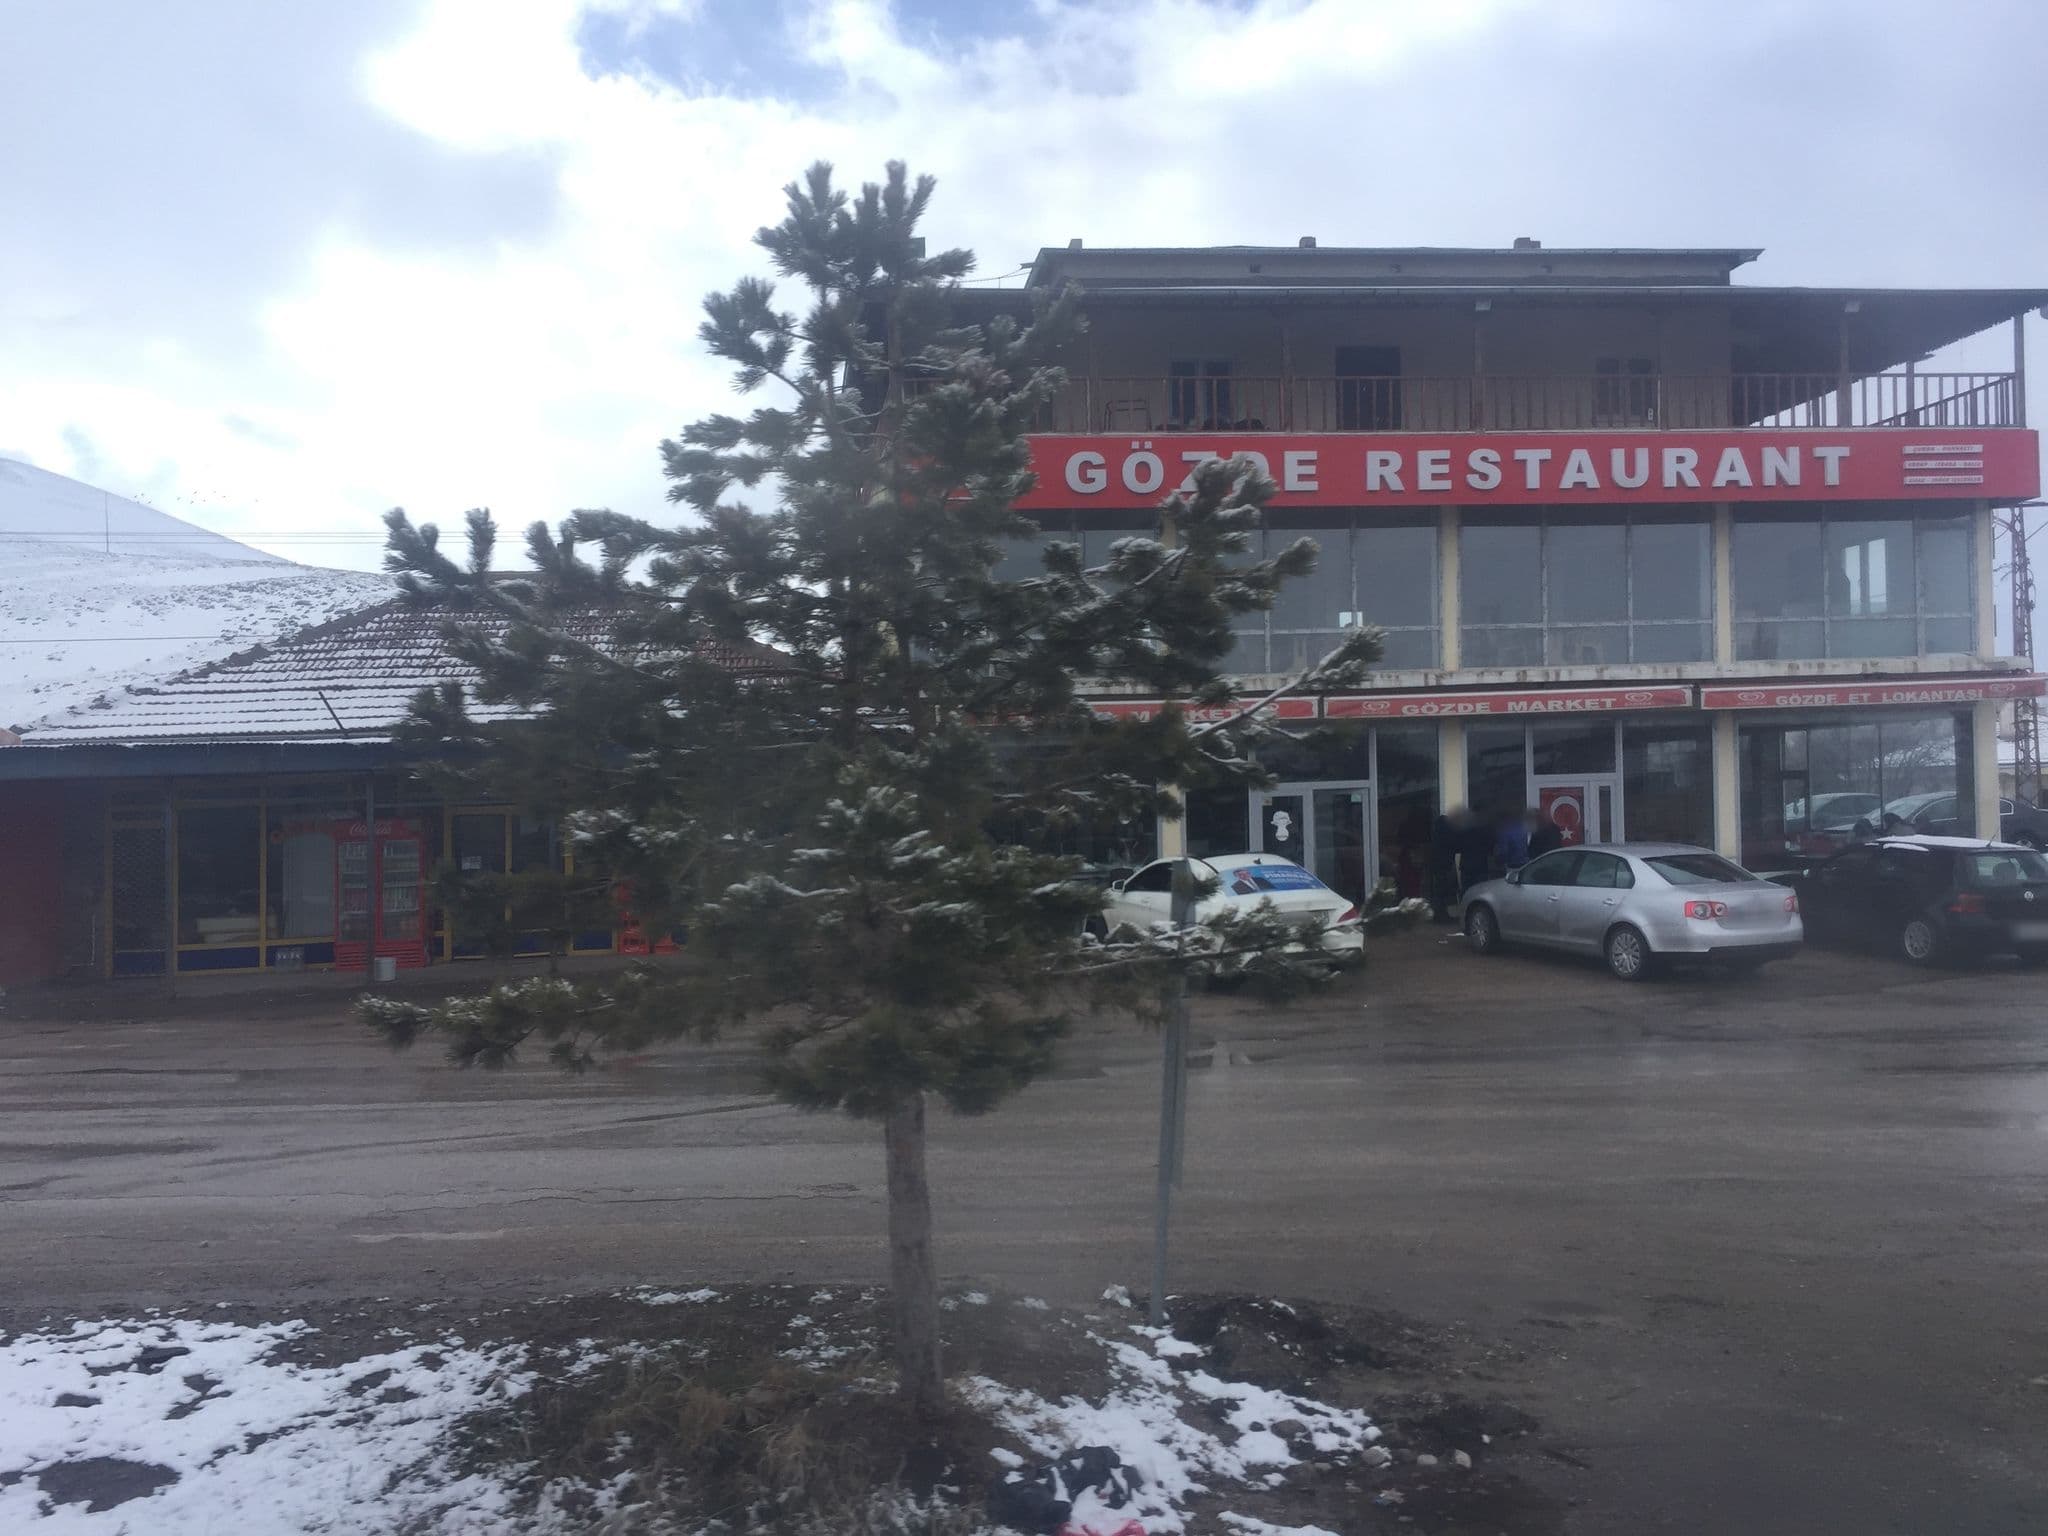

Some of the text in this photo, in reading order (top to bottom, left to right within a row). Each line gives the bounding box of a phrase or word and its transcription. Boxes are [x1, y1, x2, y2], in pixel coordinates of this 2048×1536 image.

[1365, 445, 1851, 492] RESTAURANT
[1775, 689, 1983, 706] GÖZDE ET LOKANTASI
[1132, 708, 1240, 721] MKET
[1401, 698, 1617, 716] GÖZDE MARKET
[349, 822, 392, 836] Cocaola
